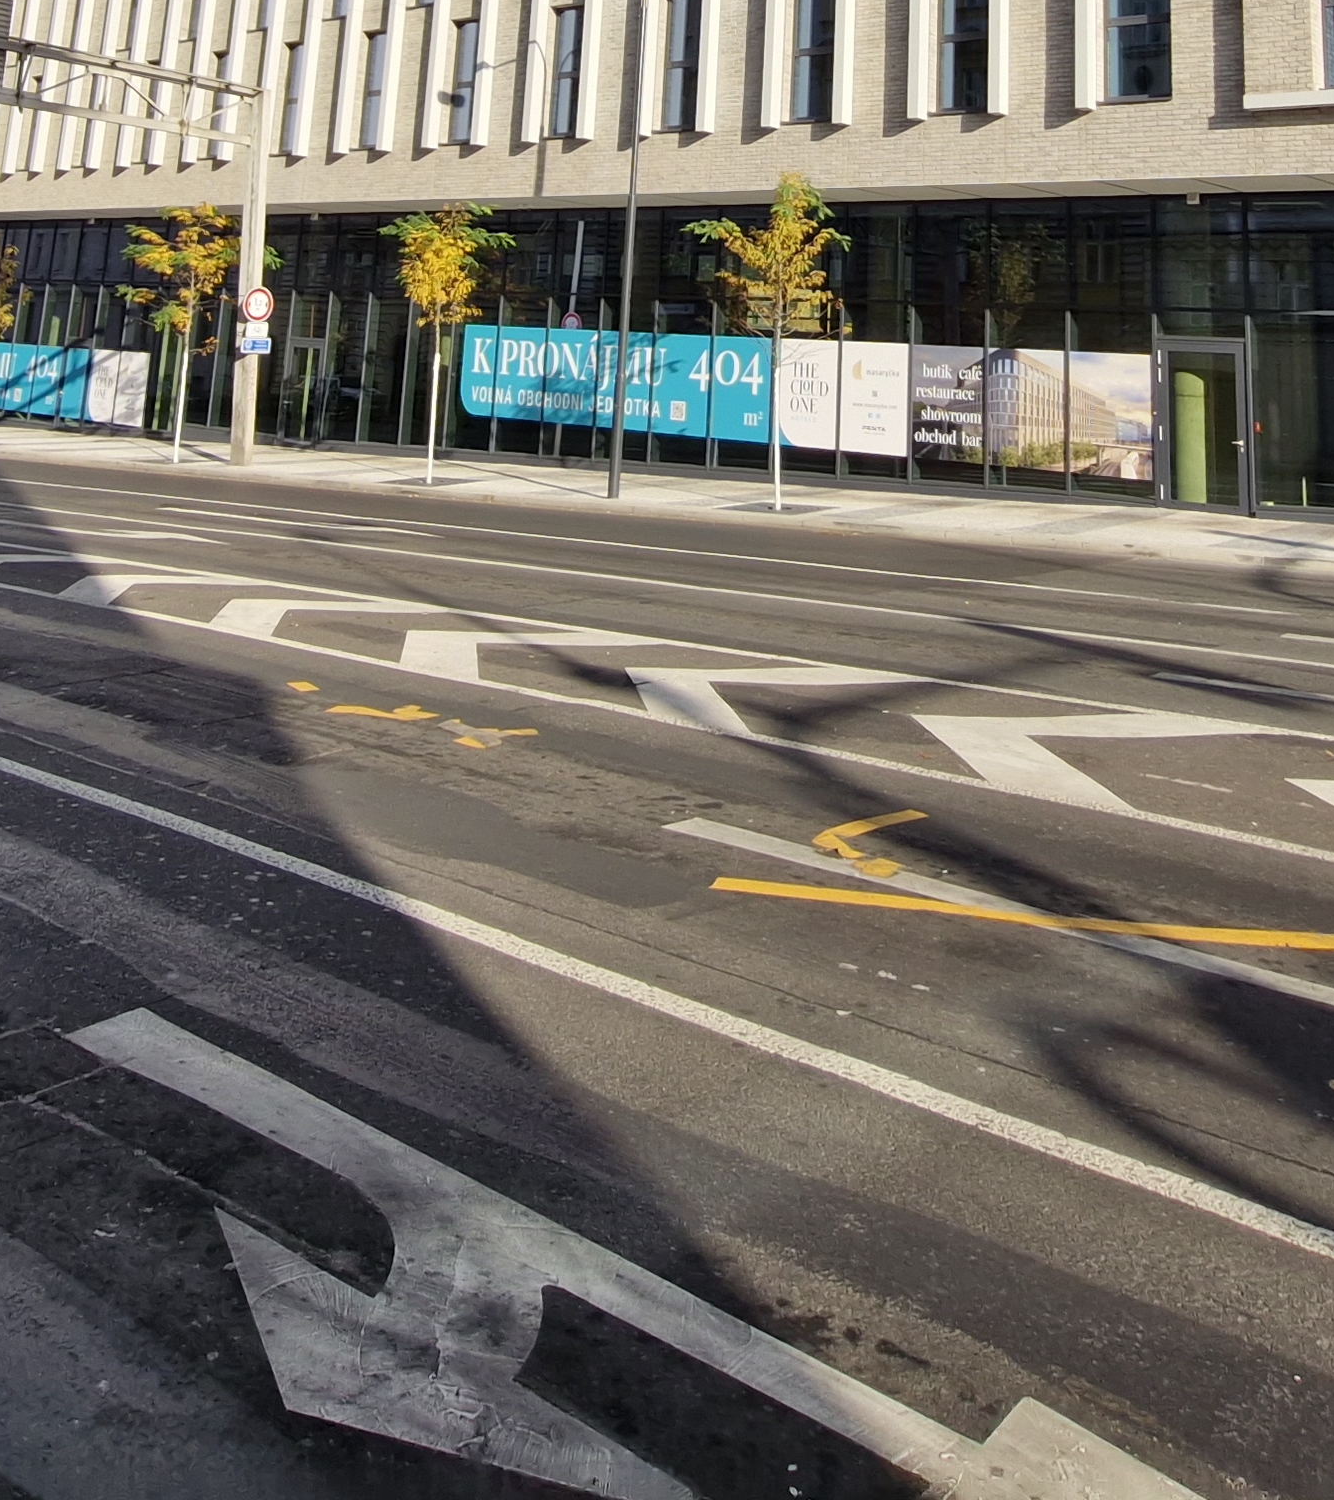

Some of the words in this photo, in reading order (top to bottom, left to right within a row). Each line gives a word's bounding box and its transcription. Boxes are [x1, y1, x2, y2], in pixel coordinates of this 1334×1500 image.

[26, 353, 58, 384] 404
[471, 338, 493, 375] K
[499, 334, 667, 390] PRONÁJMU
[688, 349, 764, 396] 404
[792, 361, 820, 379] THE
[923, 363, 952, 379] butik
[959, 365, 982, 381] café
[790, 379, 829, 397] CLOUD
[915, 385, 975, 401] restaurace
[471, 384, 512, 405] VOLNÁ
[518, 390, 586, 412] OBCHODNÍ
[588, 395, 660, 418] JEDOTKA
[790, 396, 819, 414] ONE
[921, 405, 982, 425] showroom
[914, 427, 957, 445] obchod
[962, 431, 982, 447] bar
